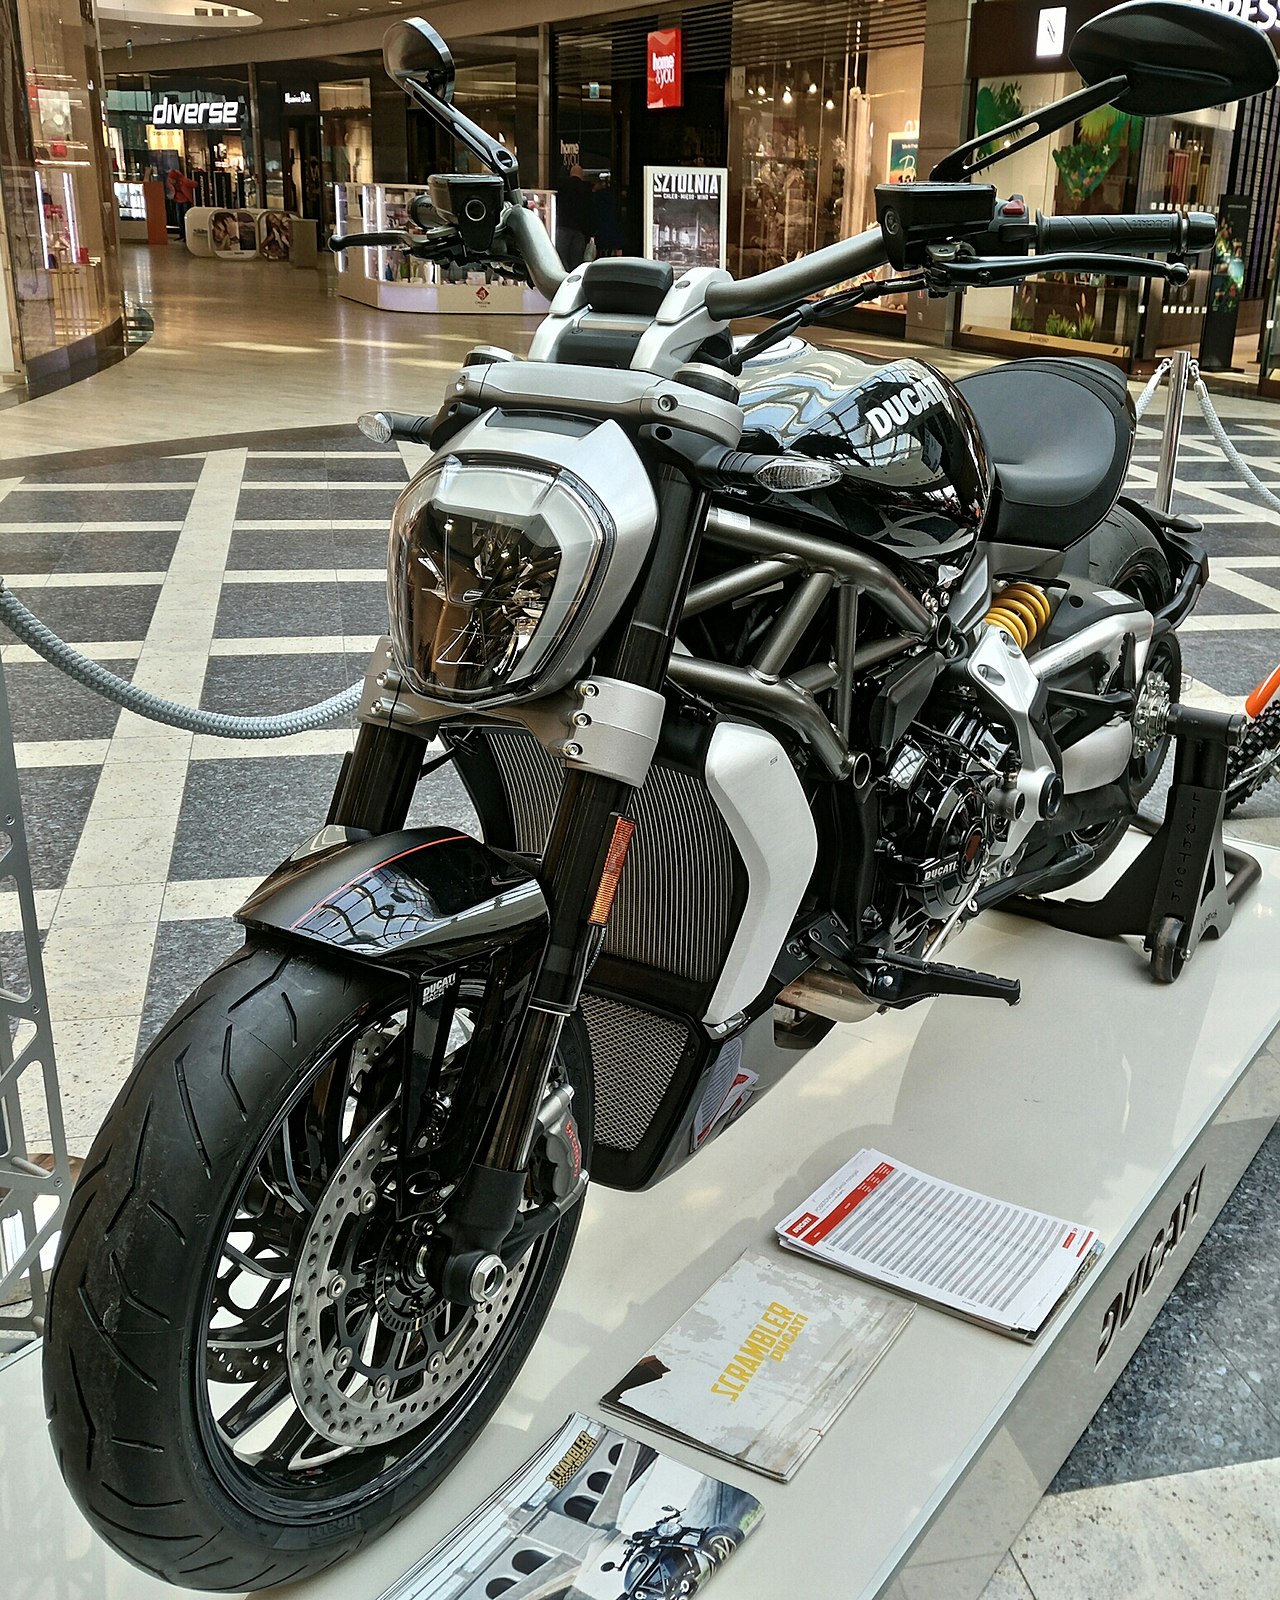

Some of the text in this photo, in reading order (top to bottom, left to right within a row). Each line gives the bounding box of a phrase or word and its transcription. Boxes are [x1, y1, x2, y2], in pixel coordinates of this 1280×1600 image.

[152, 96, 239, 125] diverse
[560, 139, 580, 154] home
[653, 174, 719, 194] SZTOLNIA
[864, 375, 949, 439] DUCATI
[923, 860, 959, 881] DUCATI
[422, 972, 457, 998] DUCATI
[792, 1216, 812, 1234] DUCATI
[1094, 1162, 1208, 1374] DUCATI
[710, 1301, 796, 1403] SCRAMBLER
[769, 1313, 809, 1362] DUCATI
[546, 1431, 592, 1486] SCRAMBLER
